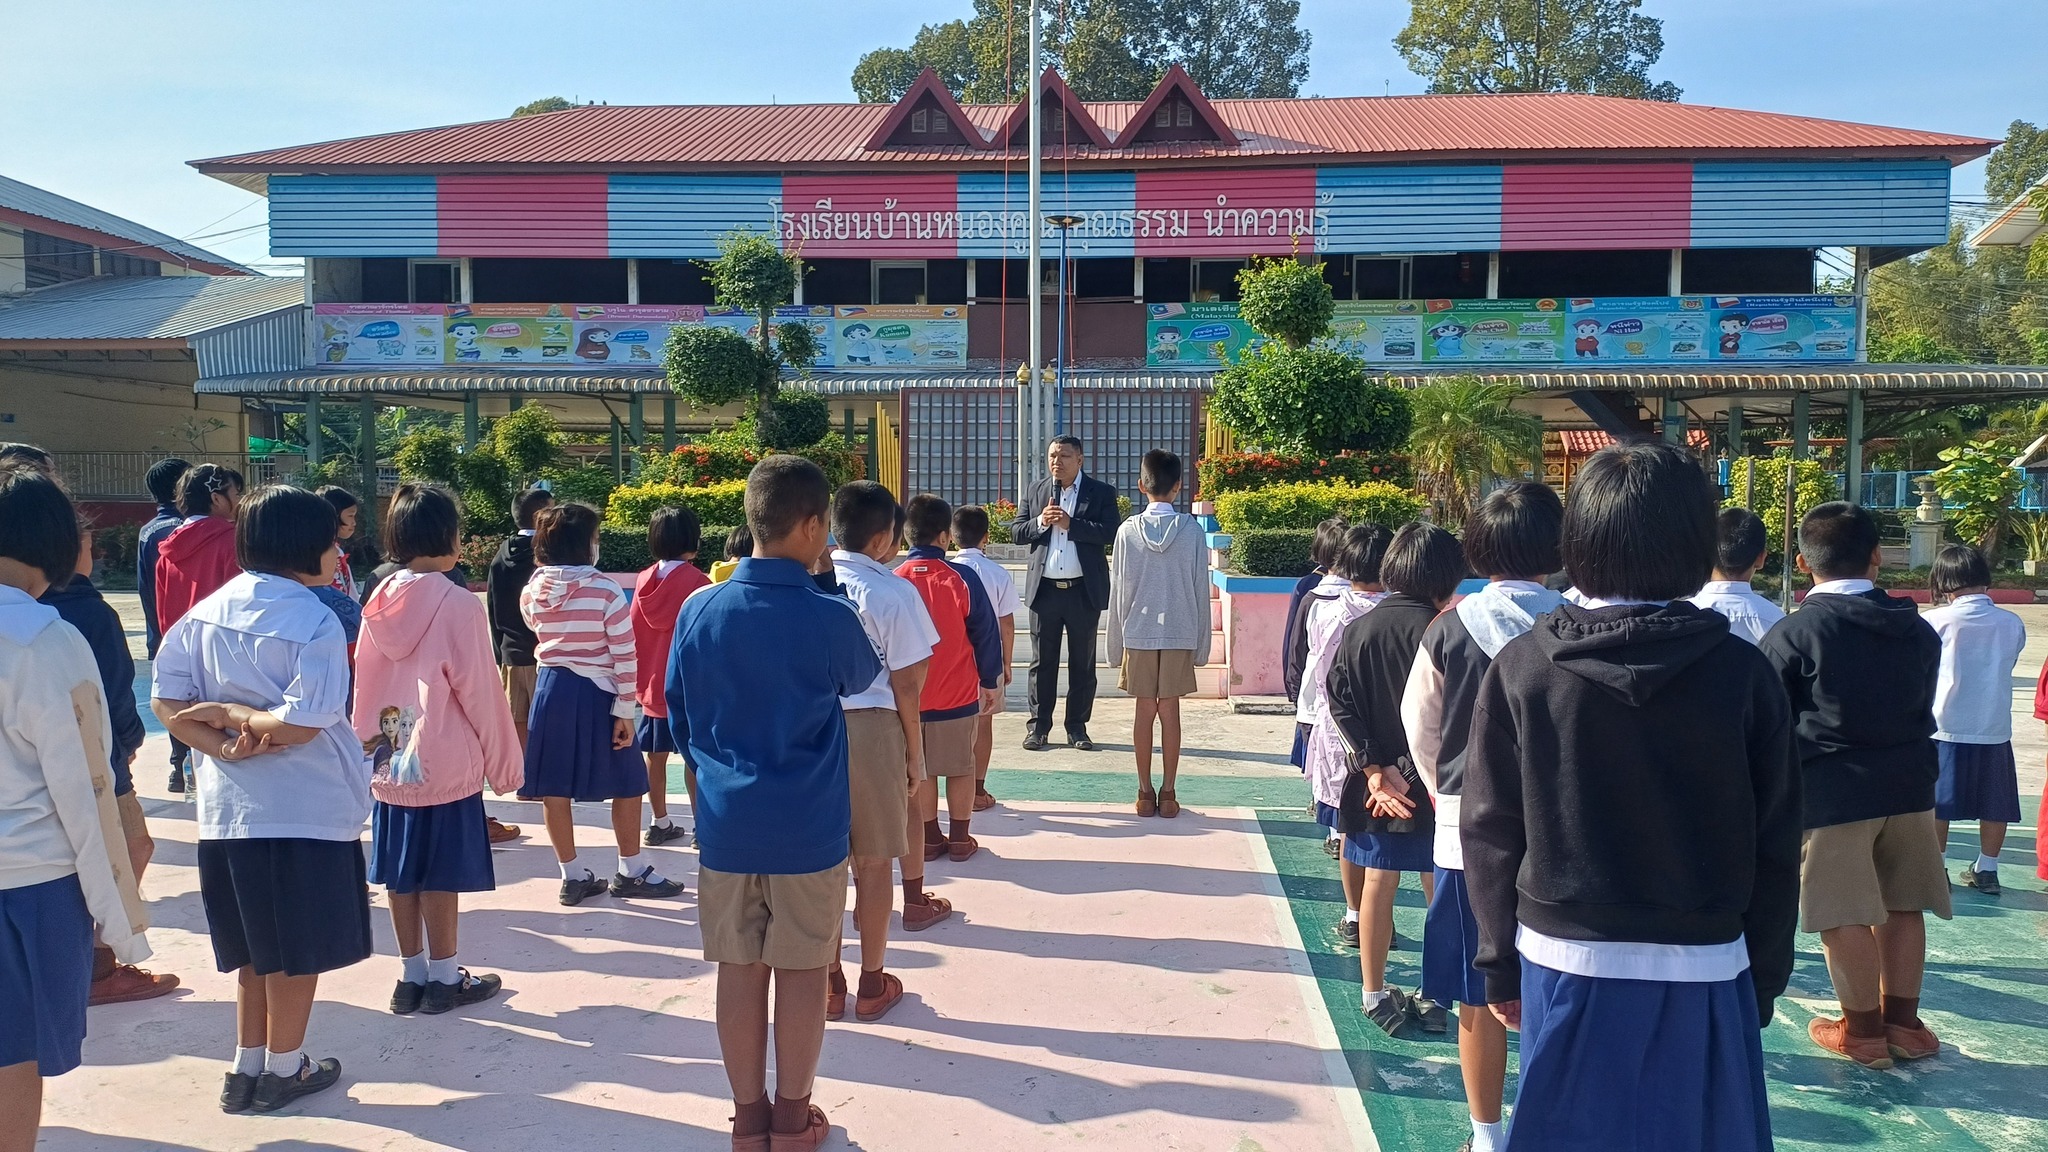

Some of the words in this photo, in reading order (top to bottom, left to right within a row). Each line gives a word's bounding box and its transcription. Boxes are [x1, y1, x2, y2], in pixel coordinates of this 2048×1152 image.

[1072, 209, 1189, 254] คุณธรรม
[1203, 191, 1335, 252] นำความรู้
